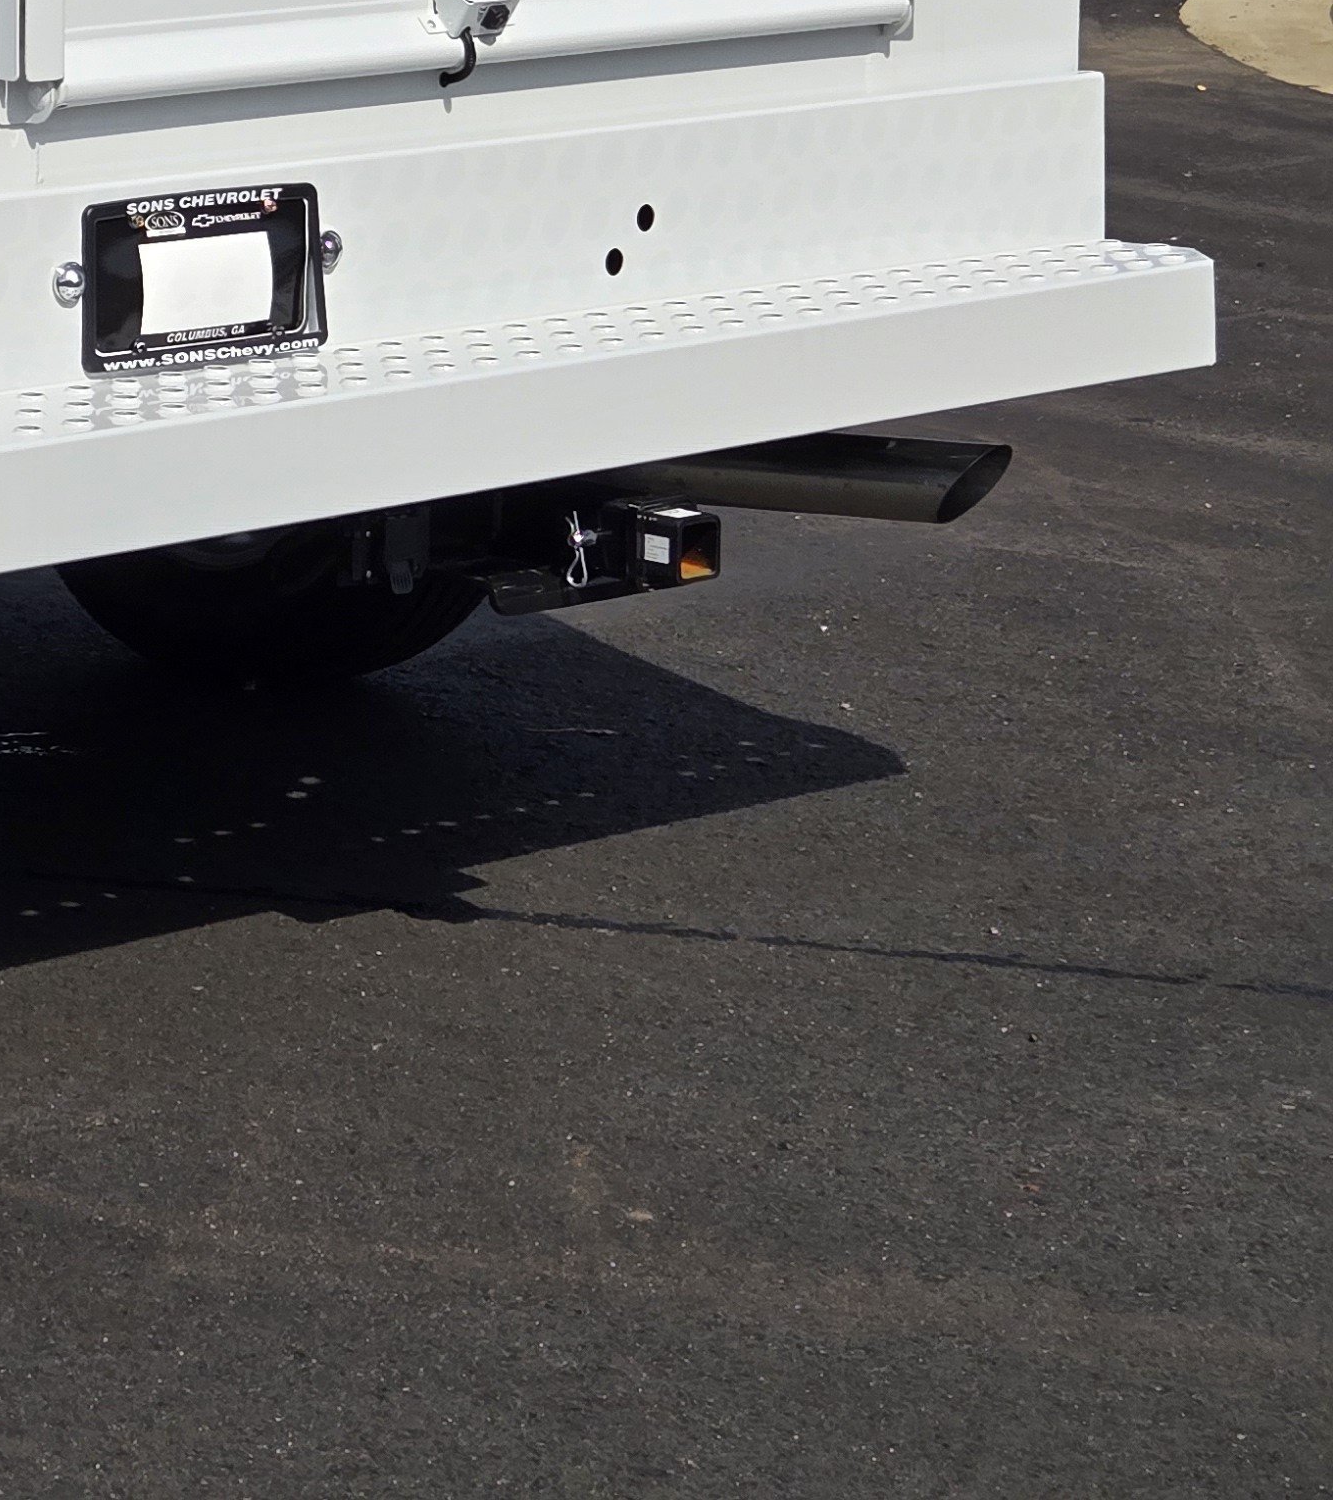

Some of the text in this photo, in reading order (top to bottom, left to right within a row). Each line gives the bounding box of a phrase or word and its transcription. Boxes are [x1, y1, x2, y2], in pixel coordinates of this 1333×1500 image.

[126, 187, 283, 216] SONS CHEVROLET
[150, 214, 180, 229] SONS
[166, 324, 246, 343] COLUMBUS, GA
[103, 337, 320, 372] www.SONSChevy.com
